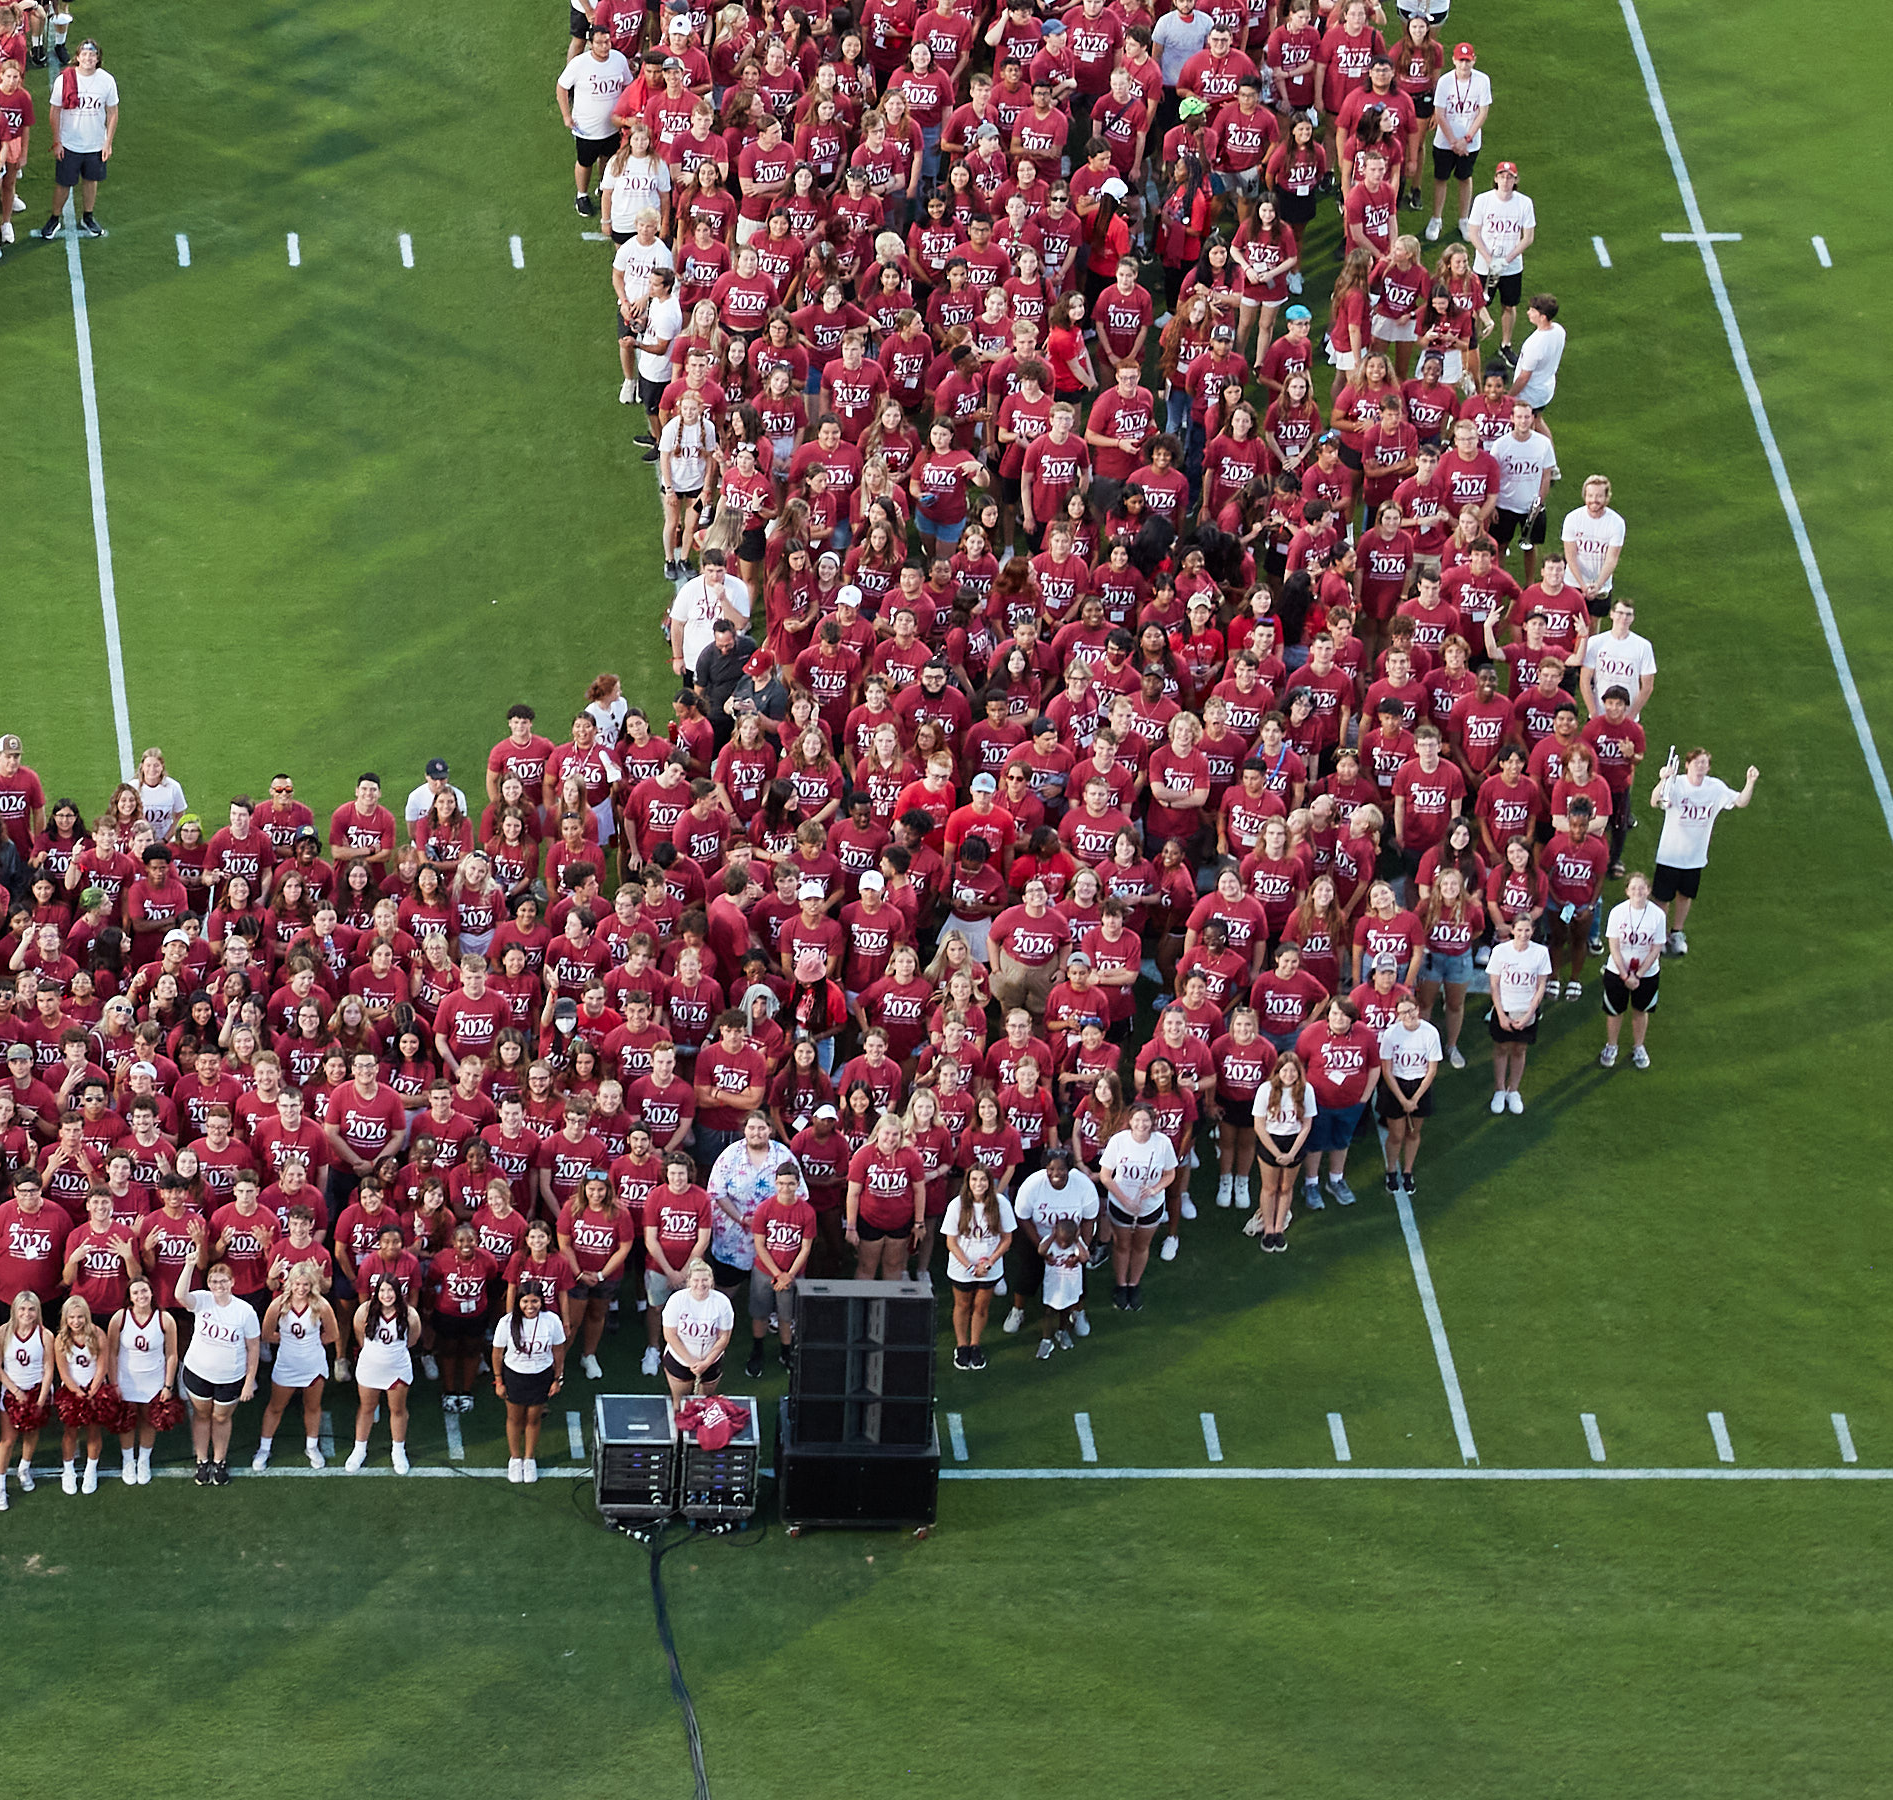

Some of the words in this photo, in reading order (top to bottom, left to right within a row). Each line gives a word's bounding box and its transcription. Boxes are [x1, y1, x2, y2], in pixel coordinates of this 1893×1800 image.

[758, 166, 786, 181] 2026
[624, 176, 657, 191] 2026
[1490, 221, 1520, 233] 2026
[728, 295, 767, 310] 2026
[1044, 462, 1076, 477] 2026
[1508, 462, 1538, 474] 2026
[1577, 539, 1608, 554] 2026
[1369, 558, 1406, 574] 2026
[1599, 659, 1634, 675] 2026
[1470, 722, 1503, 738] 2026
[1412, 790, 1446, 806] 2026
[1497, 806, 1528, 821] 2026
[222, 857, 260, 874] 2026
[1504, 970, 1537, 986] 2026
[456, 1018, 494, 1036] 2026
[1393, 1052, 1428, 1067] 2026
[868, 1172, 908, 1190] 2026
[83, 1253, 122, 1270] 2026
[680, 1322, 718, 1338] 2026
